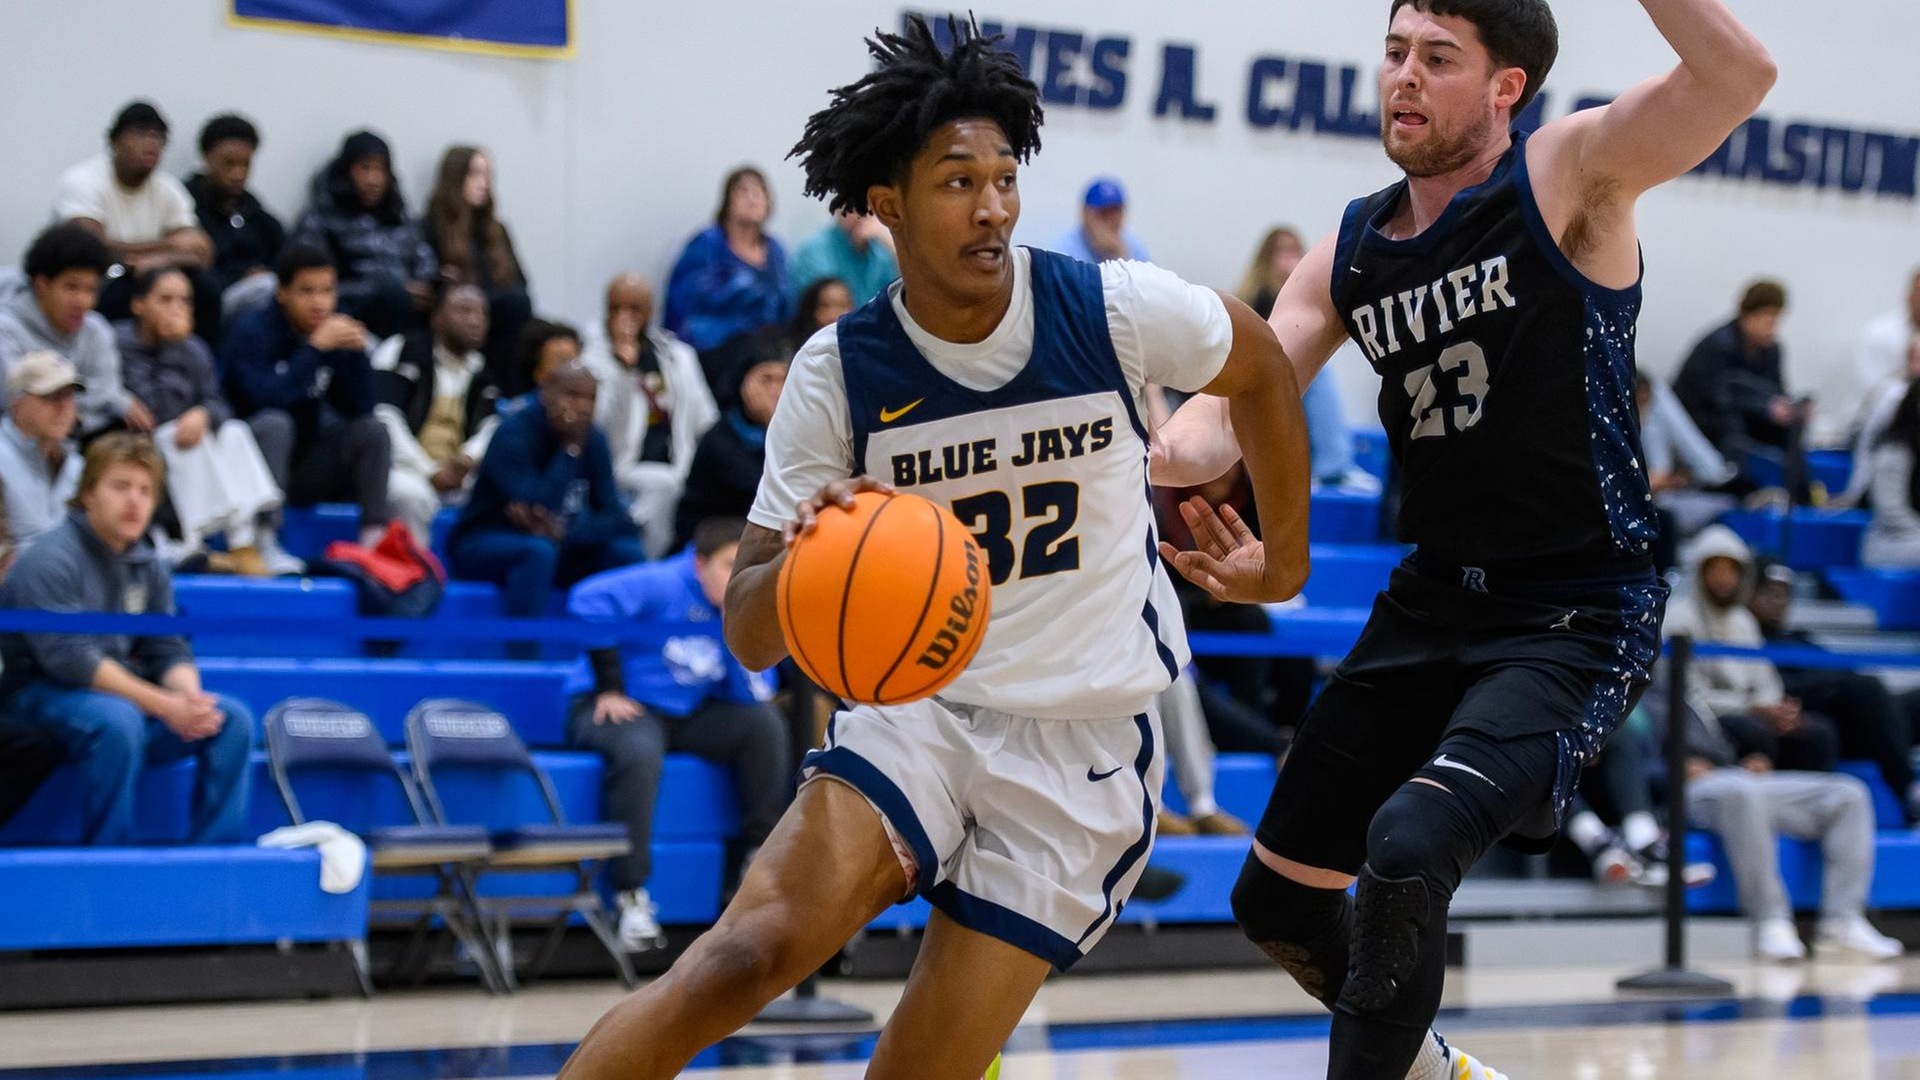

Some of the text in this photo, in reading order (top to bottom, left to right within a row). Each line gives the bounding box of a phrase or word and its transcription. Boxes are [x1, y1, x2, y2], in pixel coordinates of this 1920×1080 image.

[1352, 255, 1516, 361] RIVIER
[1403, 340, 1491, 440] 23
[892, 416, 1113, 487] BLUE JAYS
[951, 481, 1080, 586] 32
[916, 540, 980, 669] Wilson
